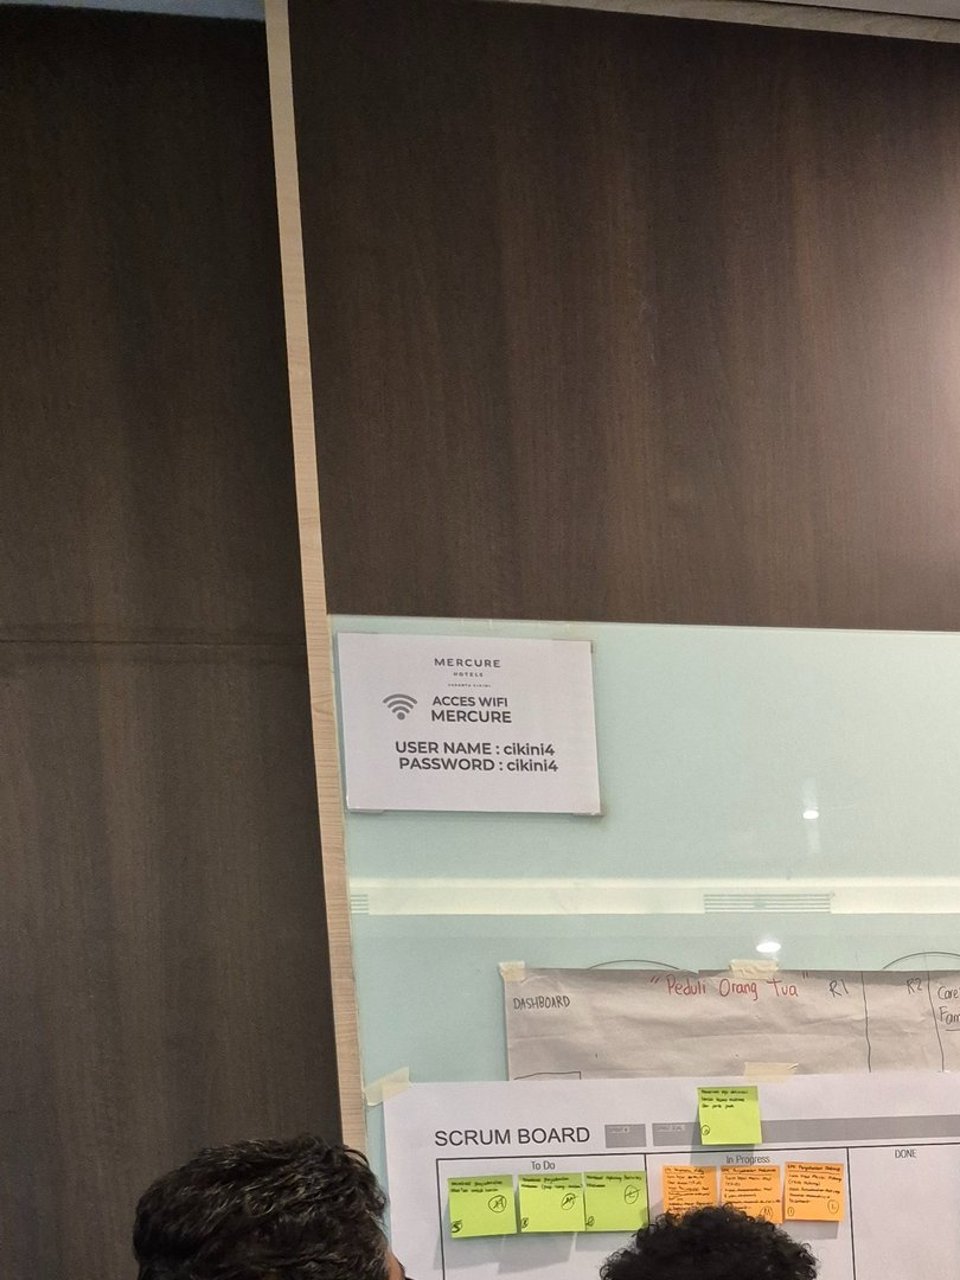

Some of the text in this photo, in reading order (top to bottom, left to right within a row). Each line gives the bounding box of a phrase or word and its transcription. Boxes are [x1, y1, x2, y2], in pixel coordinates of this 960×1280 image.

[434, 658, 501, 668] MERCURE
[432, 696, 508, 708] ACCES WIFI
[431, 710, 512, 723] MERCURE
[395, 741, 438, 754] USER
[444, 742, 492, 755] NAME
[503, 743, 555, 756] cikini4
[399, 757, 495, 771] PASSWORD
[507, 759, 558, 772] cikini4
[719, 978, 758, 1001] Orang
[513, 995, 570, 1010] DASHBOARD
[434, 1126, 590, 1147] SCRUM BOARD
[726, 1154, 770, 1166] In Progress
[894, 1149, 917, 1158] DONE
[531, 1160, 556, 1171] To Do
